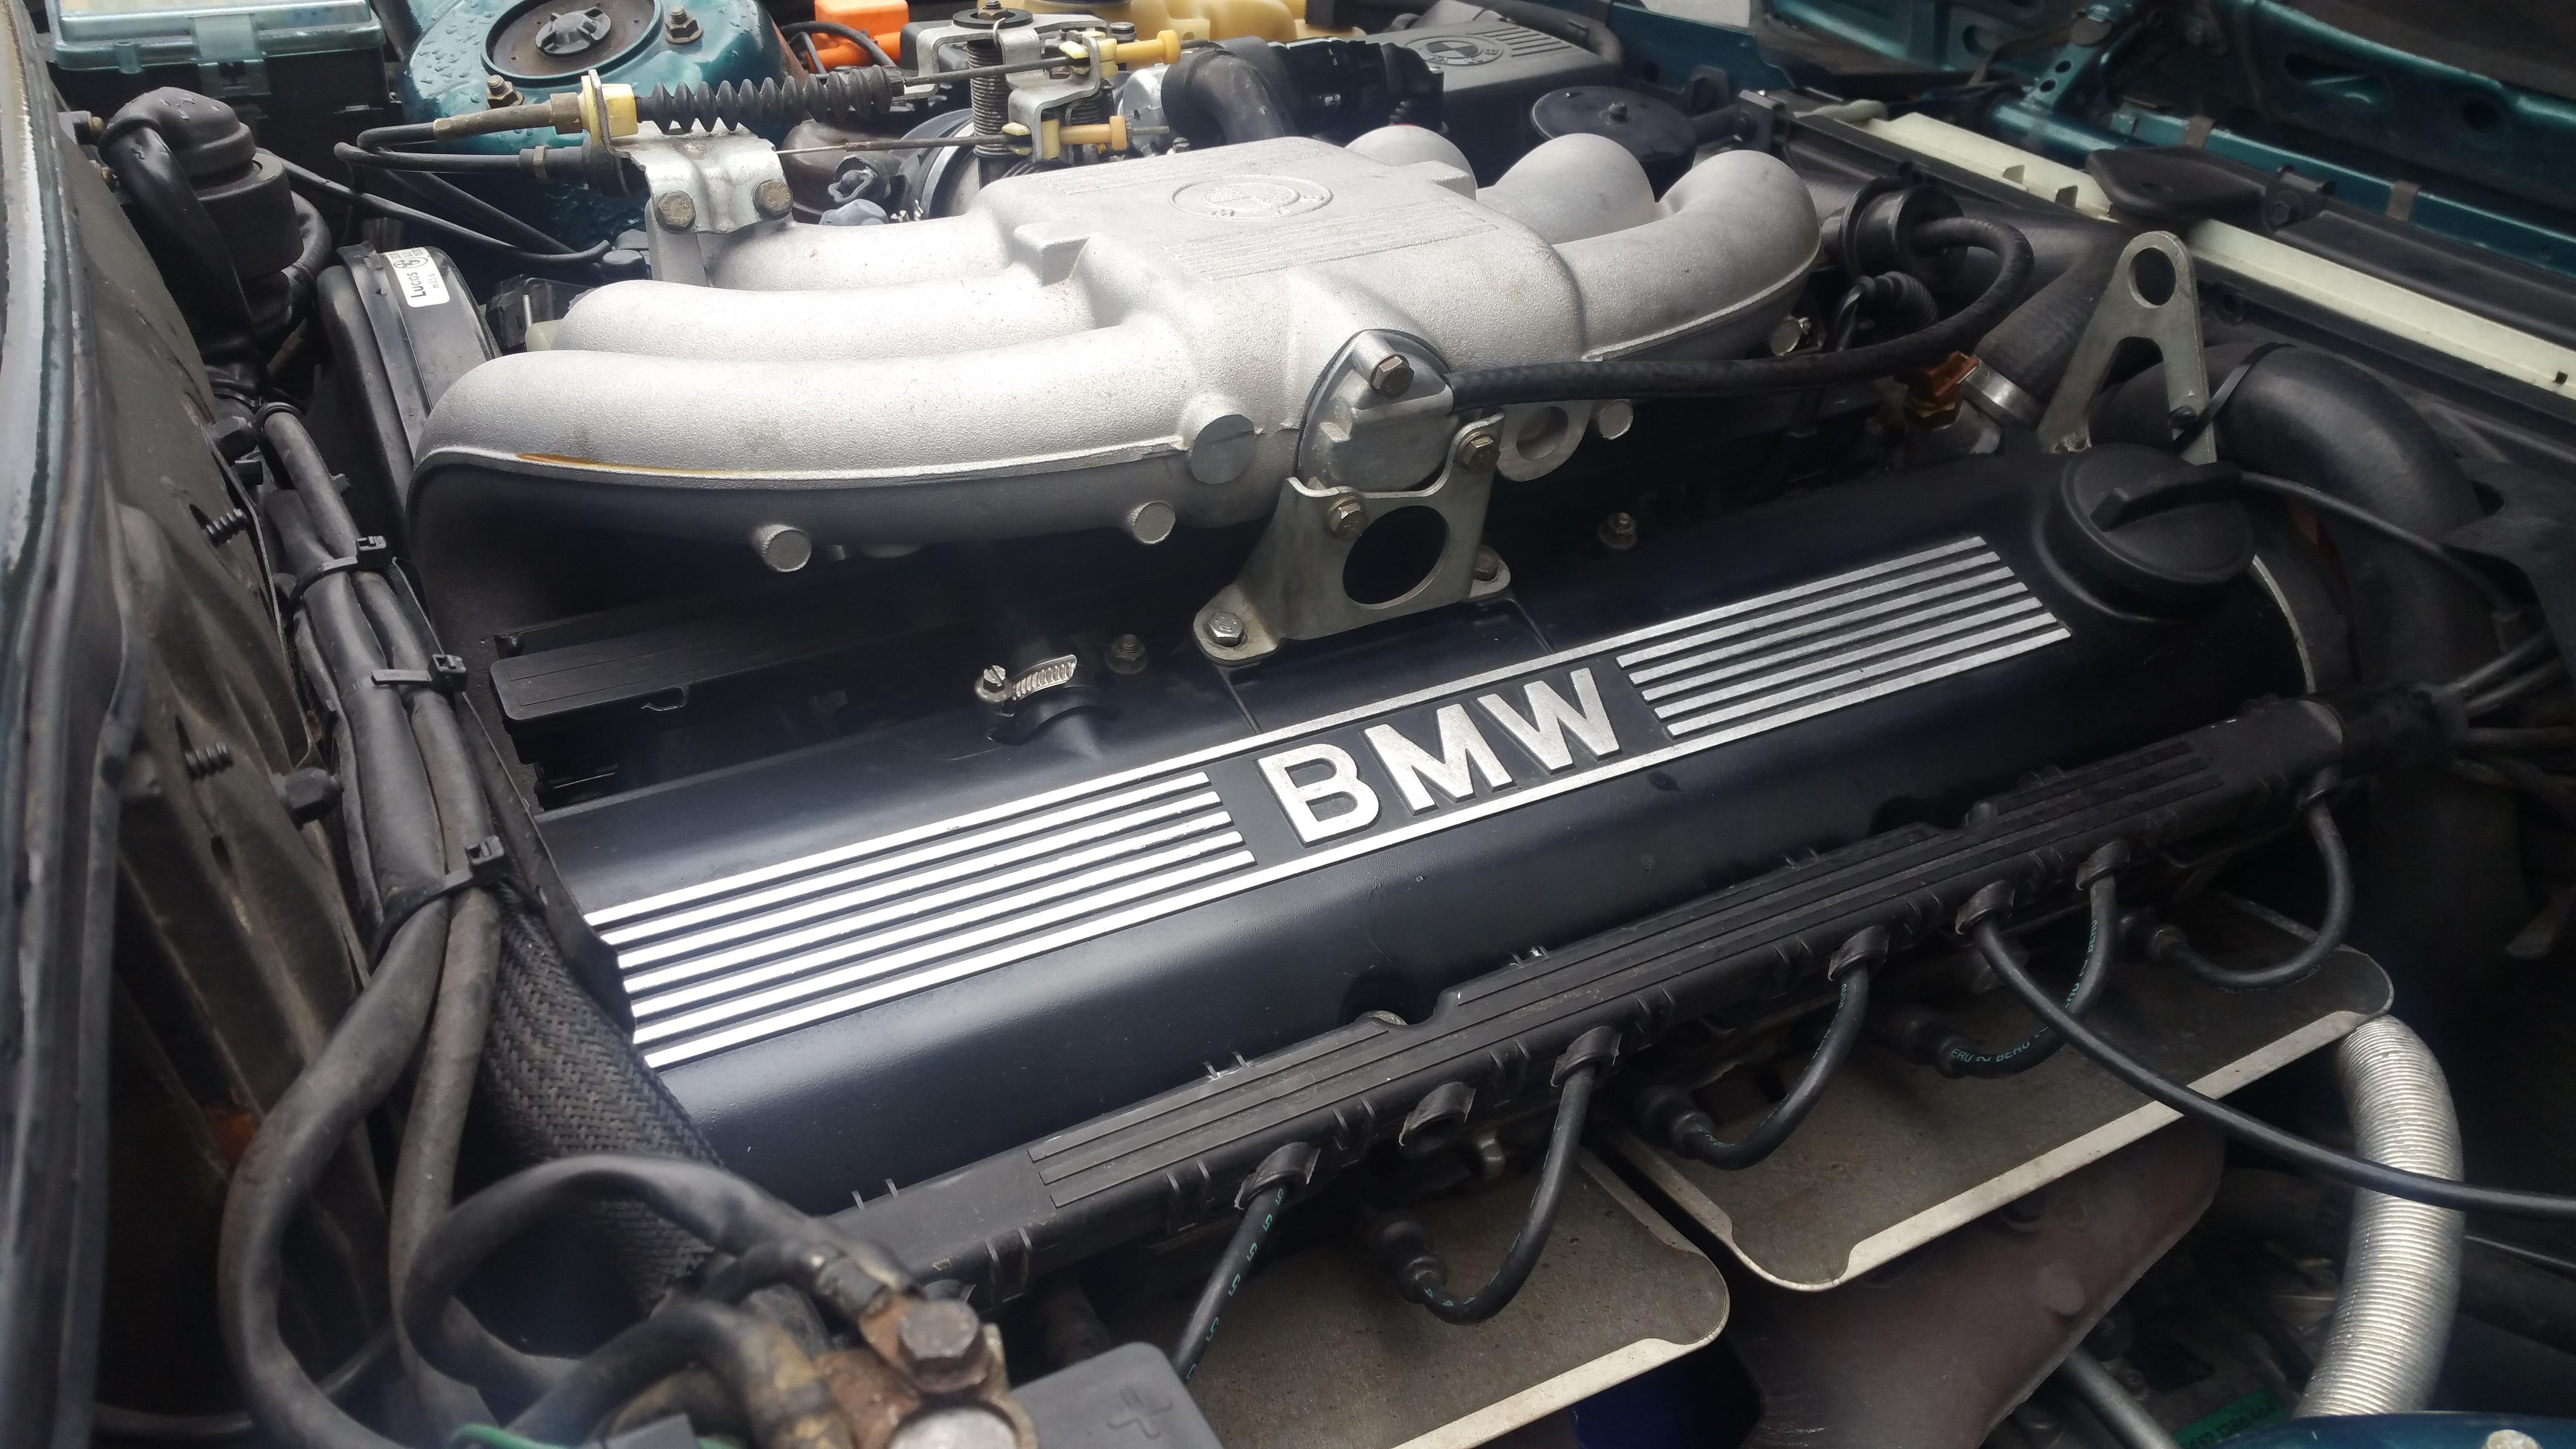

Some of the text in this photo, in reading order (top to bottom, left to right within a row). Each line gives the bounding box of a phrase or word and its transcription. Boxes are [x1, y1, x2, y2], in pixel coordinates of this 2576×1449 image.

[407, 272, 427, 299] Lucas
[1257, 667, 1622, 849] BMW
[1951, 1048, 1975, 1063] ERU
